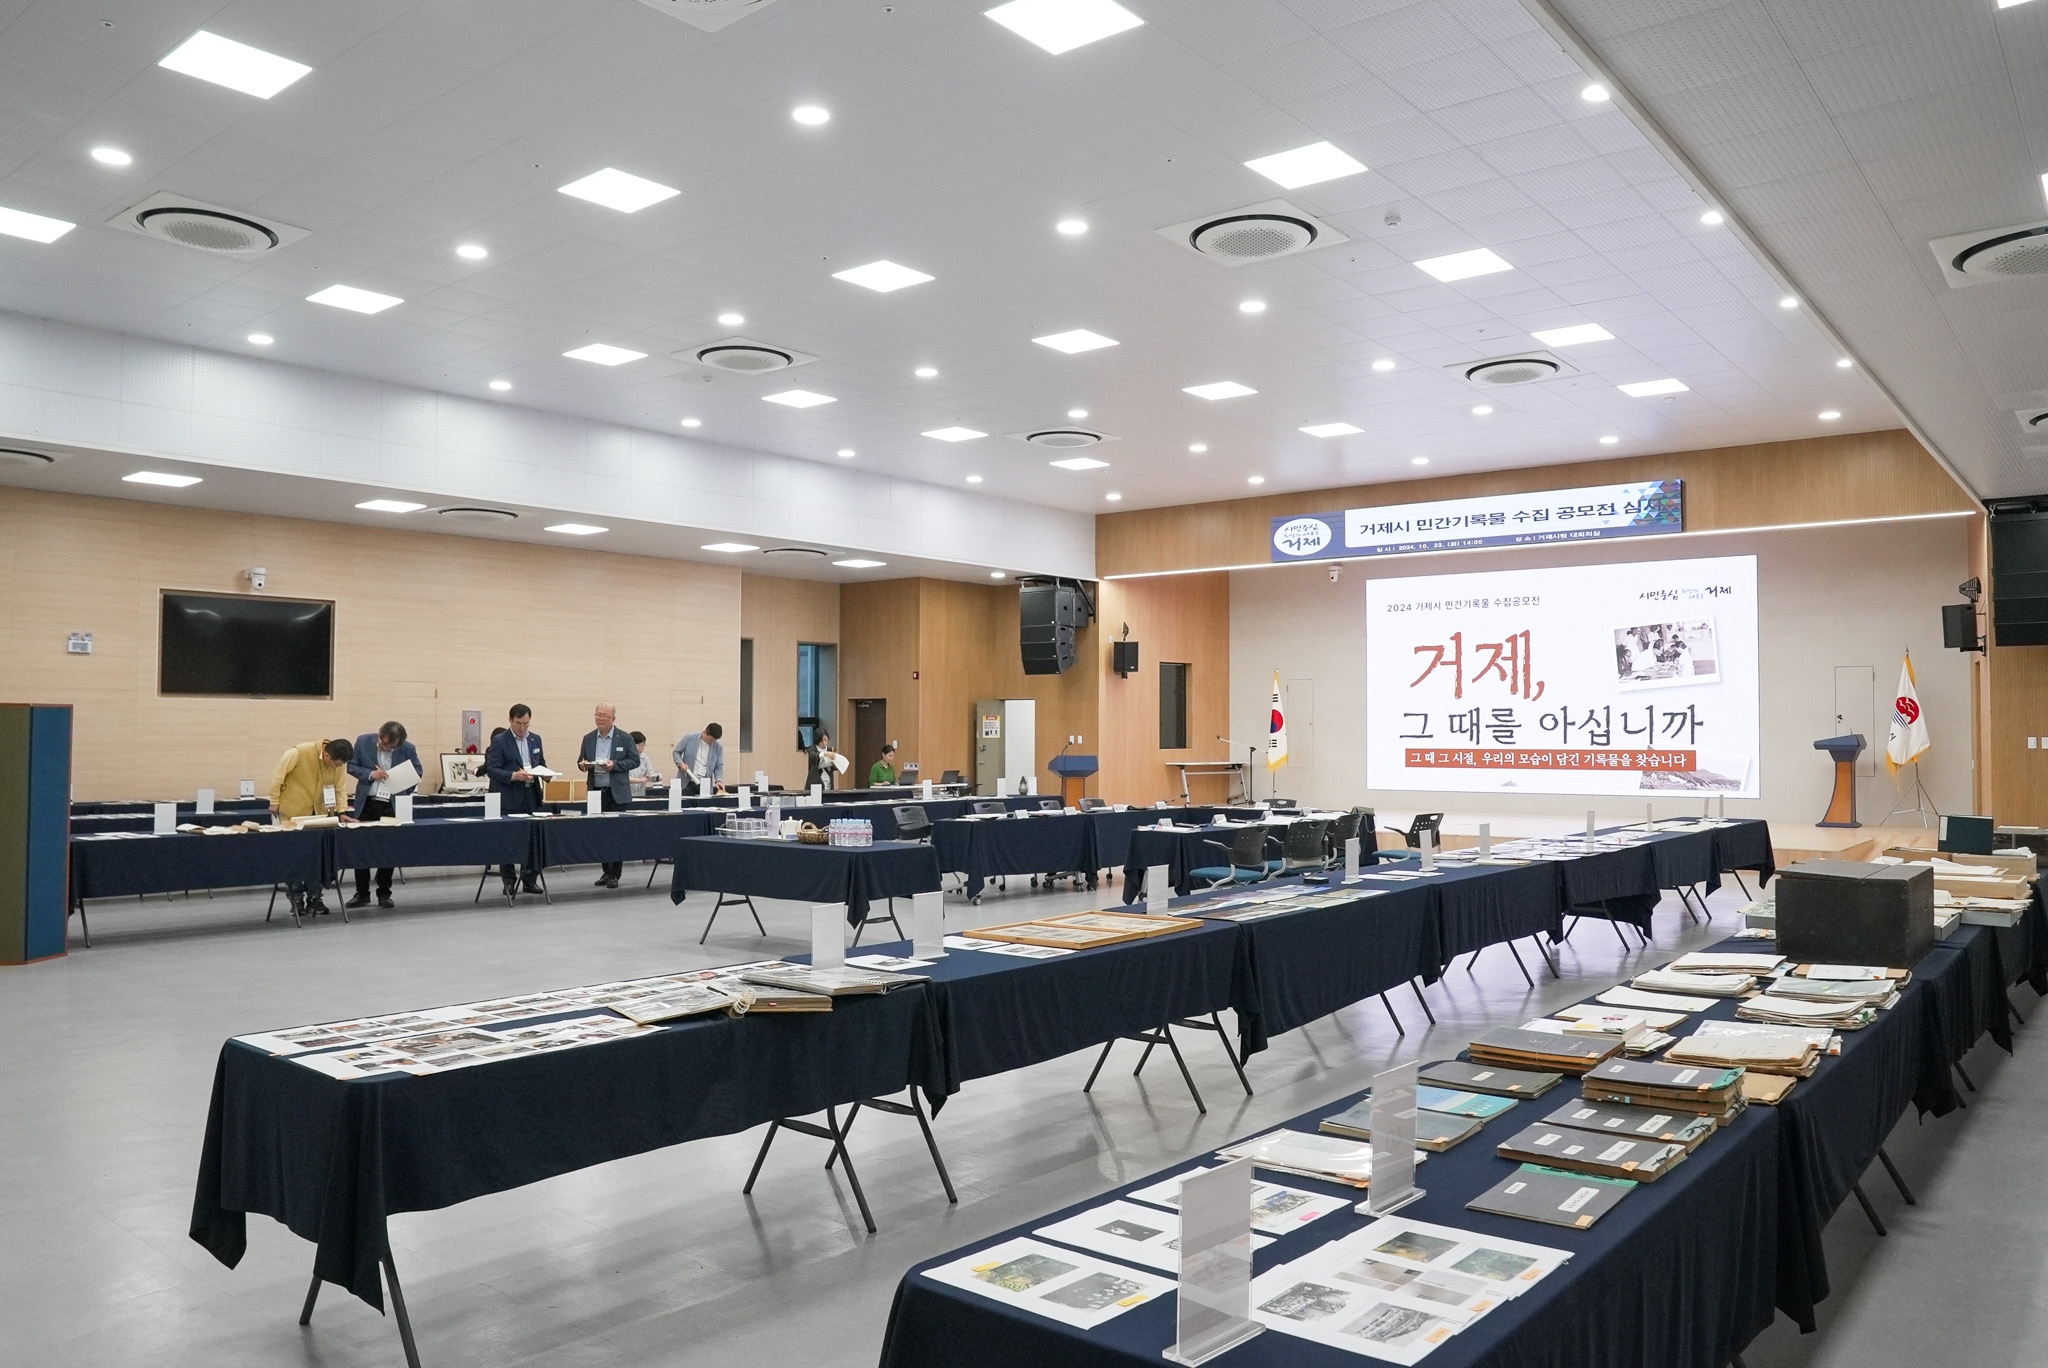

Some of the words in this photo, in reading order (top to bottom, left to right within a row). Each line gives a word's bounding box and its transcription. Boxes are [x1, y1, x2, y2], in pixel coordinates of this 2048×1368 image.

[1360, 520, 1410, 535] 거제시
[1416, 512, 1506, 531] 민간기록물
[1512, 508, 1549, 523] 수집
[1556, 502, 1615, 520] 공모전
[1282, 536, 1320, 550] 거제
[1705, 585, 1731, 597] 거제
[1387, 604, 1412, 612] 2024
[1416, 601, 1441, 611] 거제시
[1445, 598, 1489, 610] 민간기록물
[1494, 596, 1540, 607] 수집공모전
[1410, 629, 1544, 701] 거제,
[1399, 712, 1433, 739] 그
[1448, 707, 1522, 745] 때를
[1539, 704, 1704, 746] 아십니까
[1410, 752, 1421, 763] 그
[1424, 752, 1435, 764] 때
[1438, 752, 1449, 764] 그
[1452, 752, 1477, 766] 시절,
[1481, 752, 1515, 765] 우리의
[1518, 753, 1552, 766] 모습이
[1556, 753, 1580, 766] 담긴
[1584, 753, 1632, 767] 기록물을
[1636, 753, 1686, 768] 찾습니다
